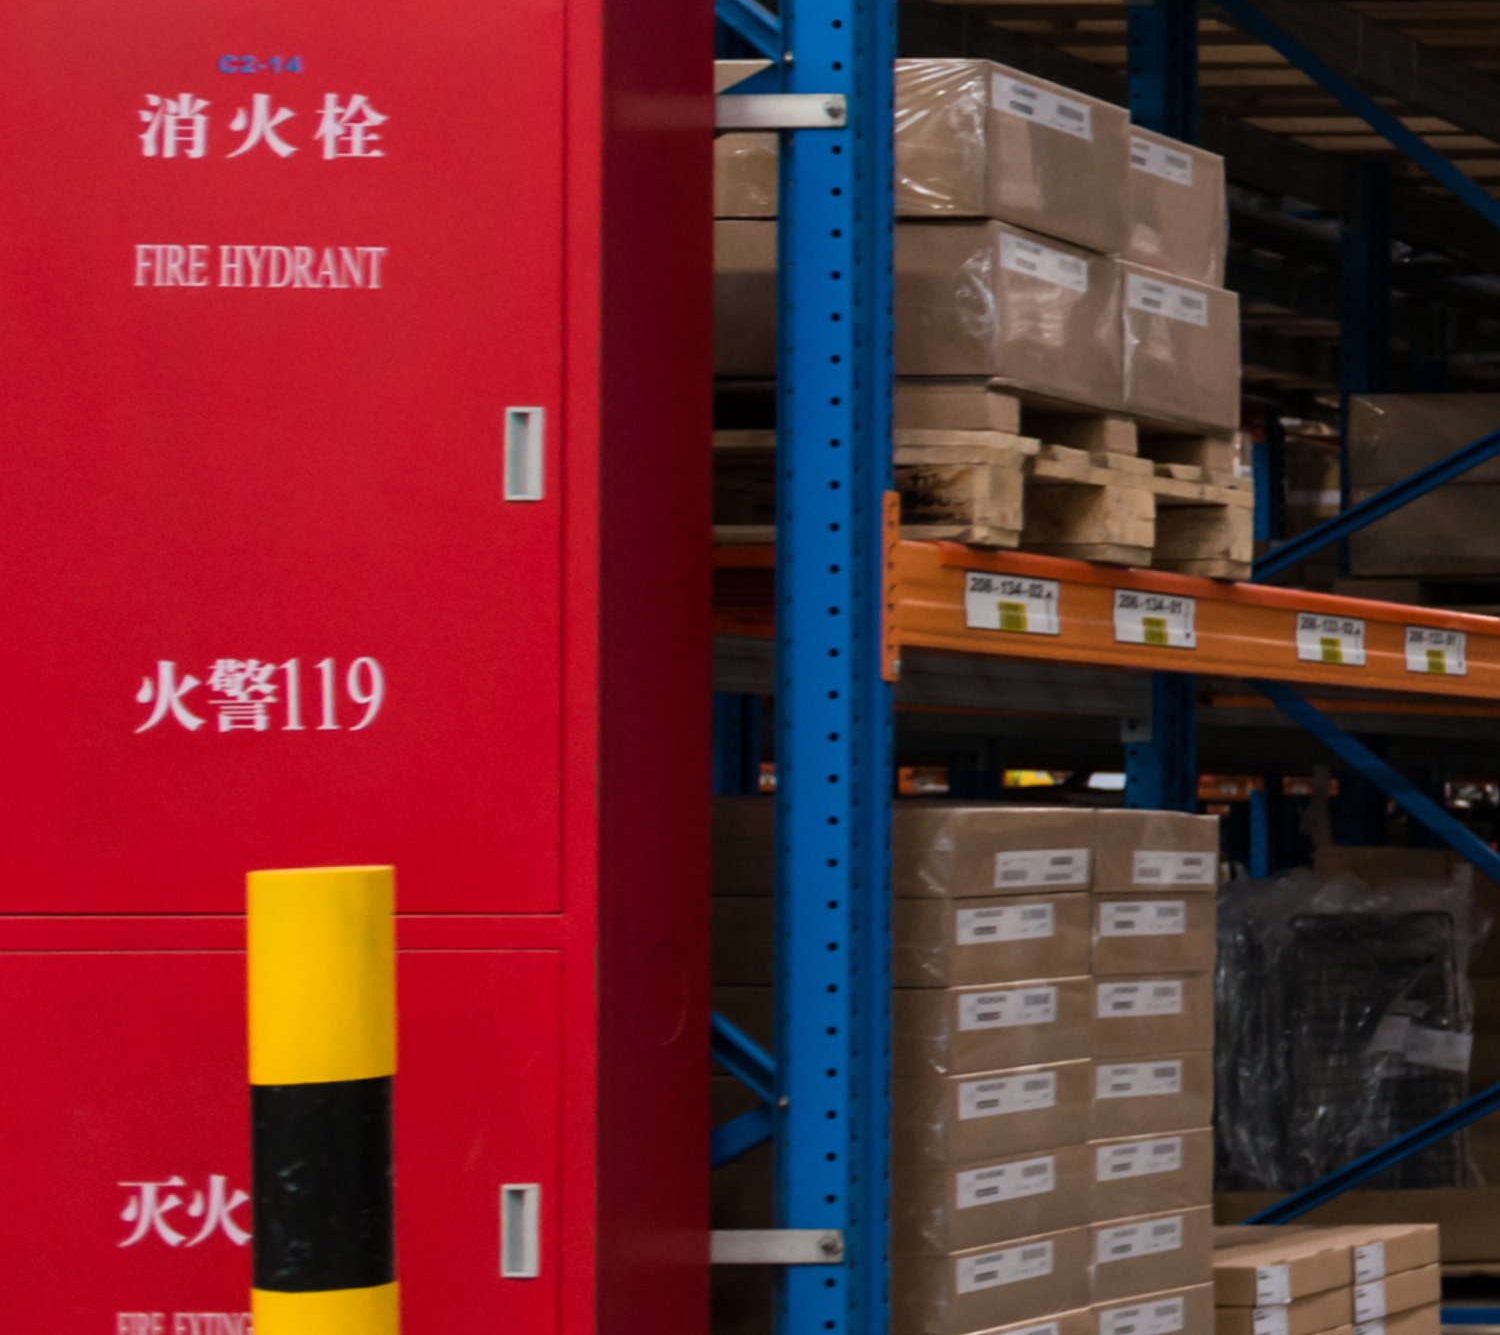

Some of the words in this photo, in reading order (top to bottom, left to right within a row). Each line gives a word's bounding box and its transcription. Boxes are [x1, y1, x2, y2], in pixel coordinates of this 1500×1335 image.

[217, 54, 303, 74] C2-14
[138, 93, 389, 161] 消火栓
[134, 244, 209, 288] FIRE
[219, 245, 387, 289] HYDRANT
[135, 657, 385, 733] 火警119
[117, 1312, 165, 1335] FIRE
